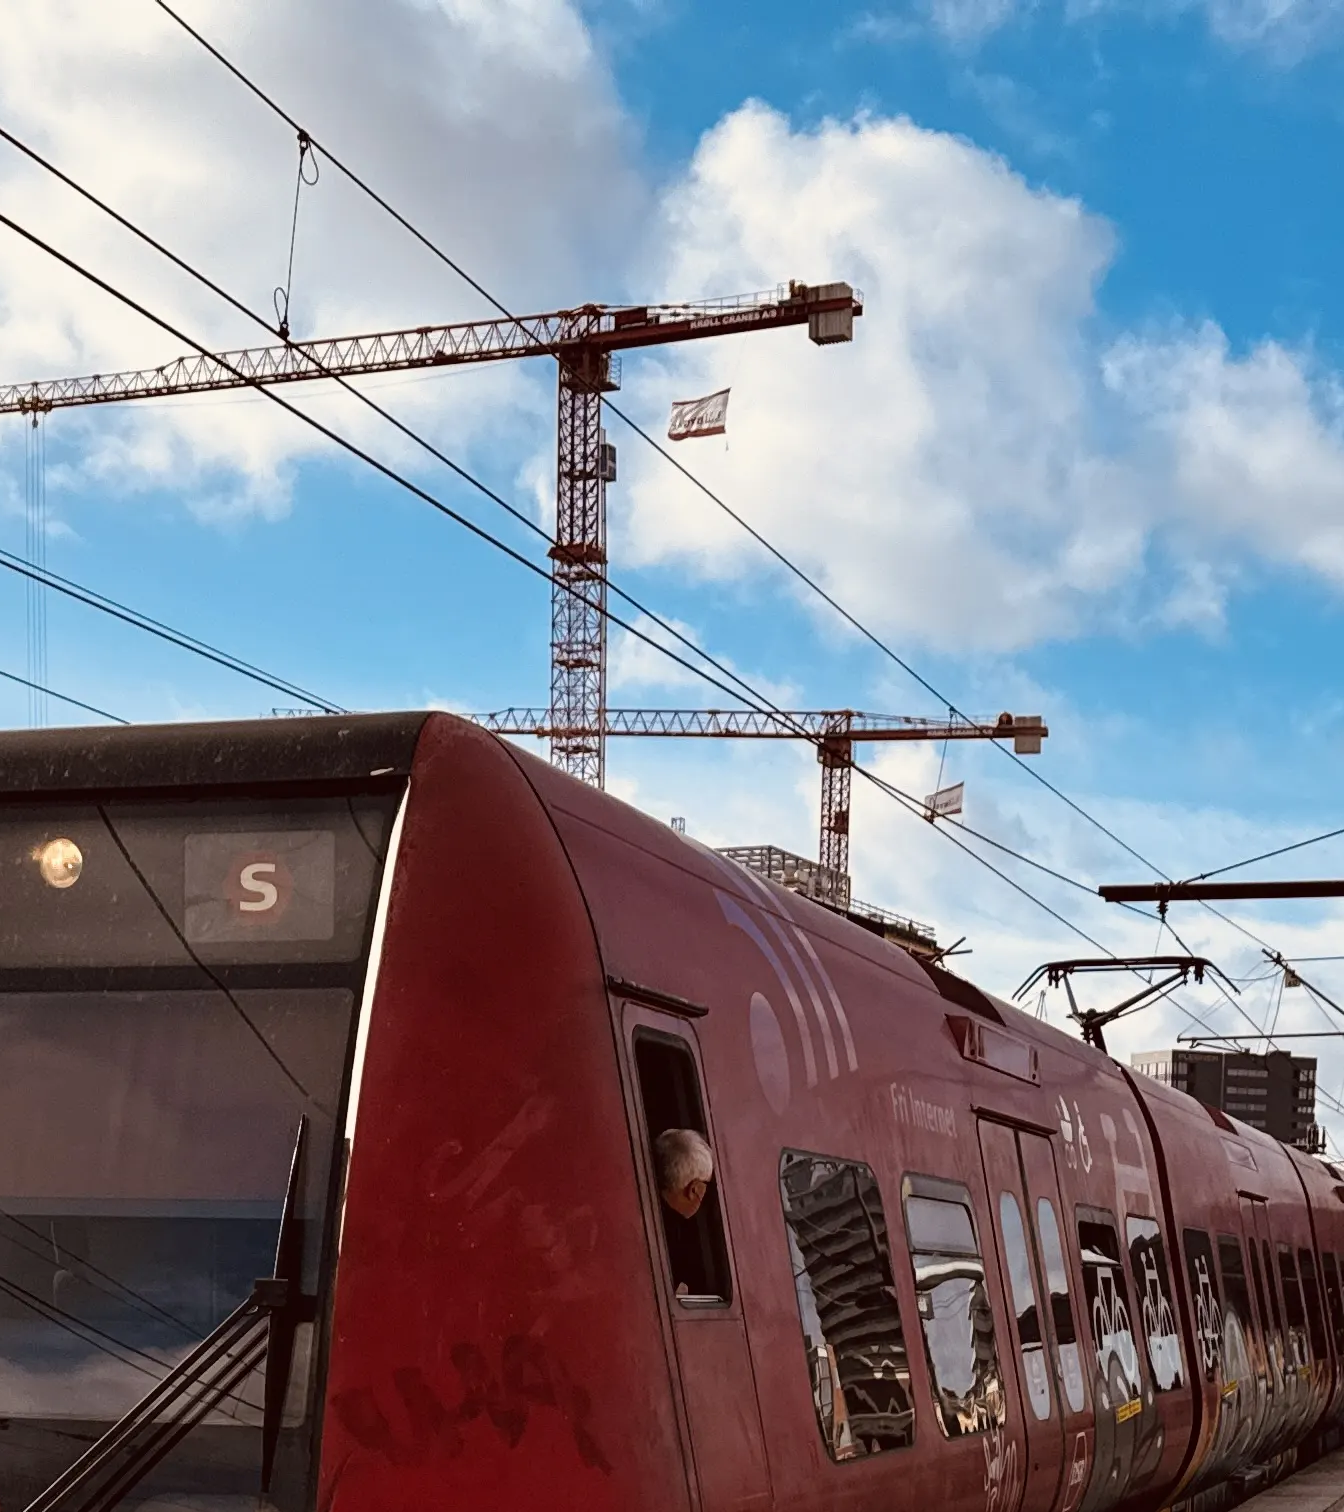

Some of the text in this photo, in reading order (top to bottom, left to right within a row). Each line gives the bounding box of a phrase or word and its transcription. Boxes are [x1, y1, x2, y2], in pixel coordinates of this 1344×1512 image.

[239, 862, 278, 912] S
[890, 1082, 958, 1139] Fri Internet
